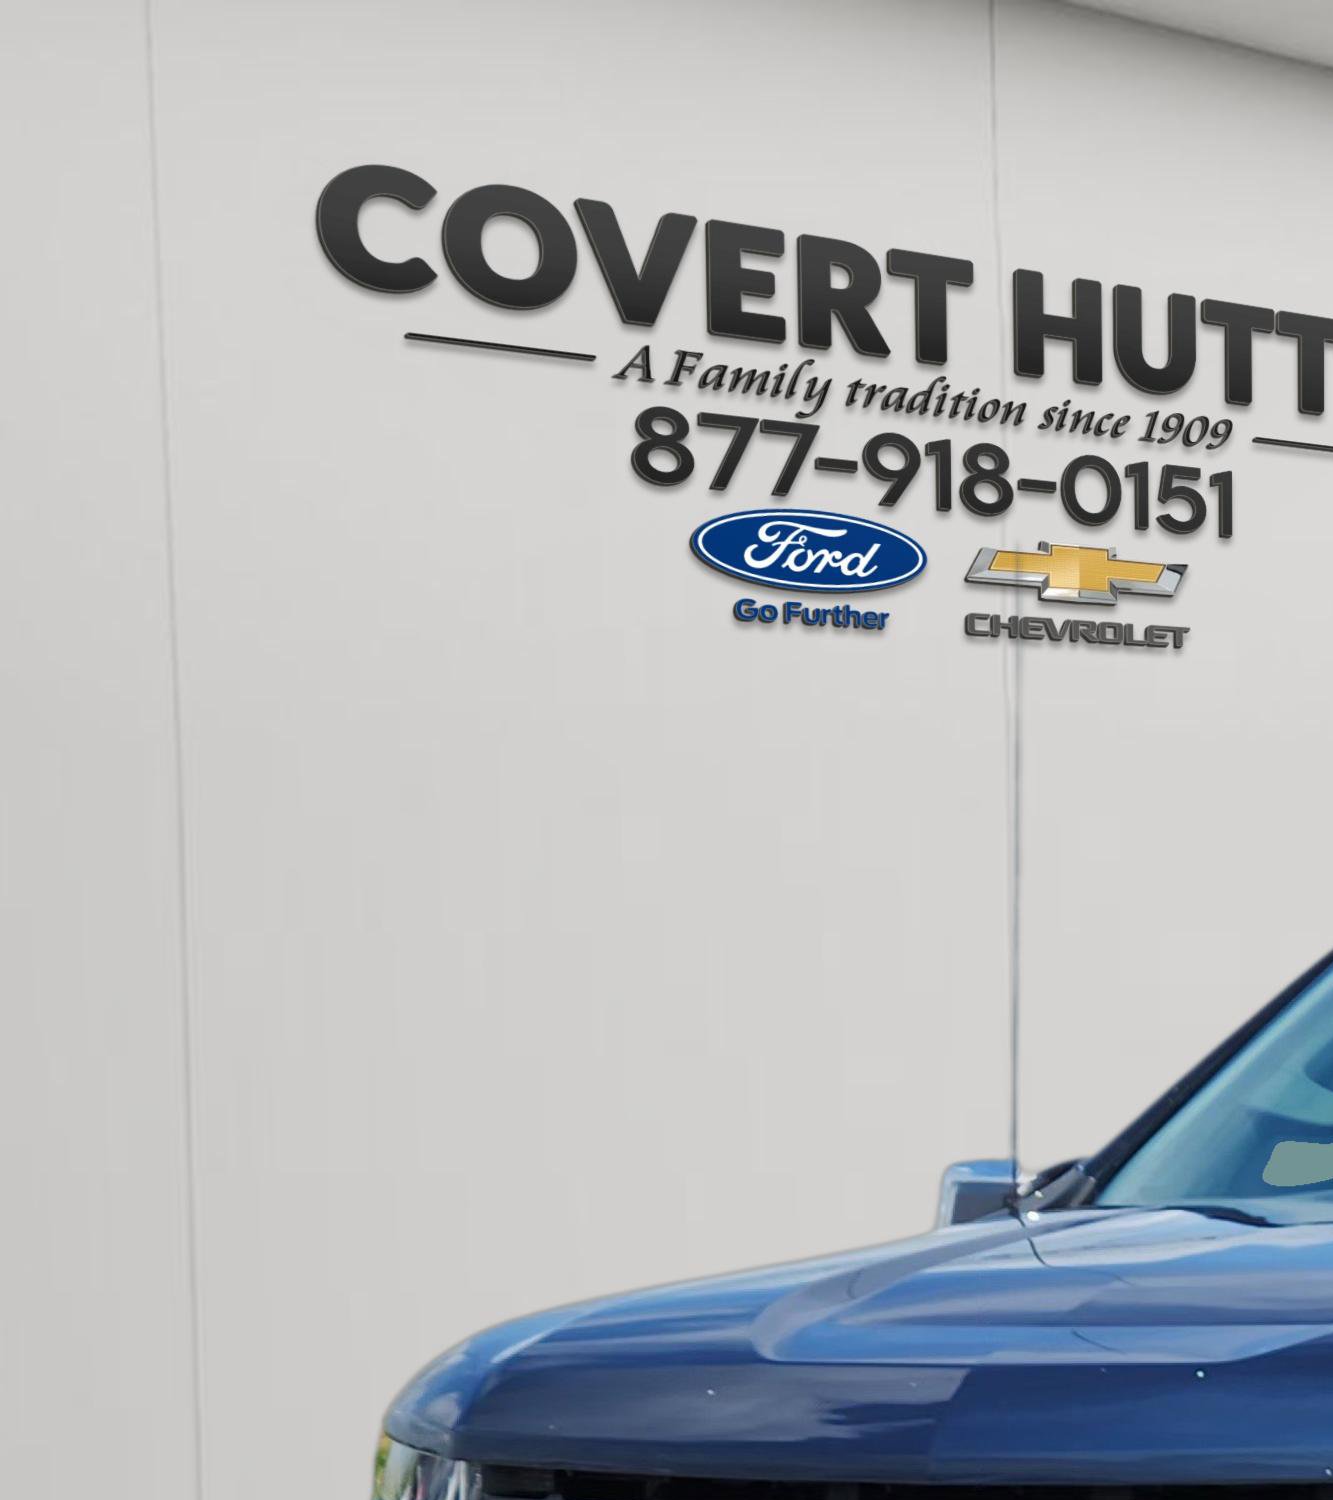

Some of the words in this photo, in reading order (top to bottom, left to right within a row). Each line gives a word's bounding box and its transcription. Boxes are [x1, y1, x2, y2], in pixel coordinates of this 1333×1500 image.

[316, 165, 973, 366] COVERT
[611, 344, 655, 384] A
[663, 349, 833, 420] Family
[845, 375, 1027, 428] tradition
[1037, 406, 1131, 440] since
[1138, 410, 1234, 451] 1909
[630, 406, 1233, 540] 877-918-0151
[743, 519, 881, 579] Ford
[732, 598, 779, 624] Go
[783, 601, 890, 632] Further
[963, 611, 1191, 650] CHEVROLET
